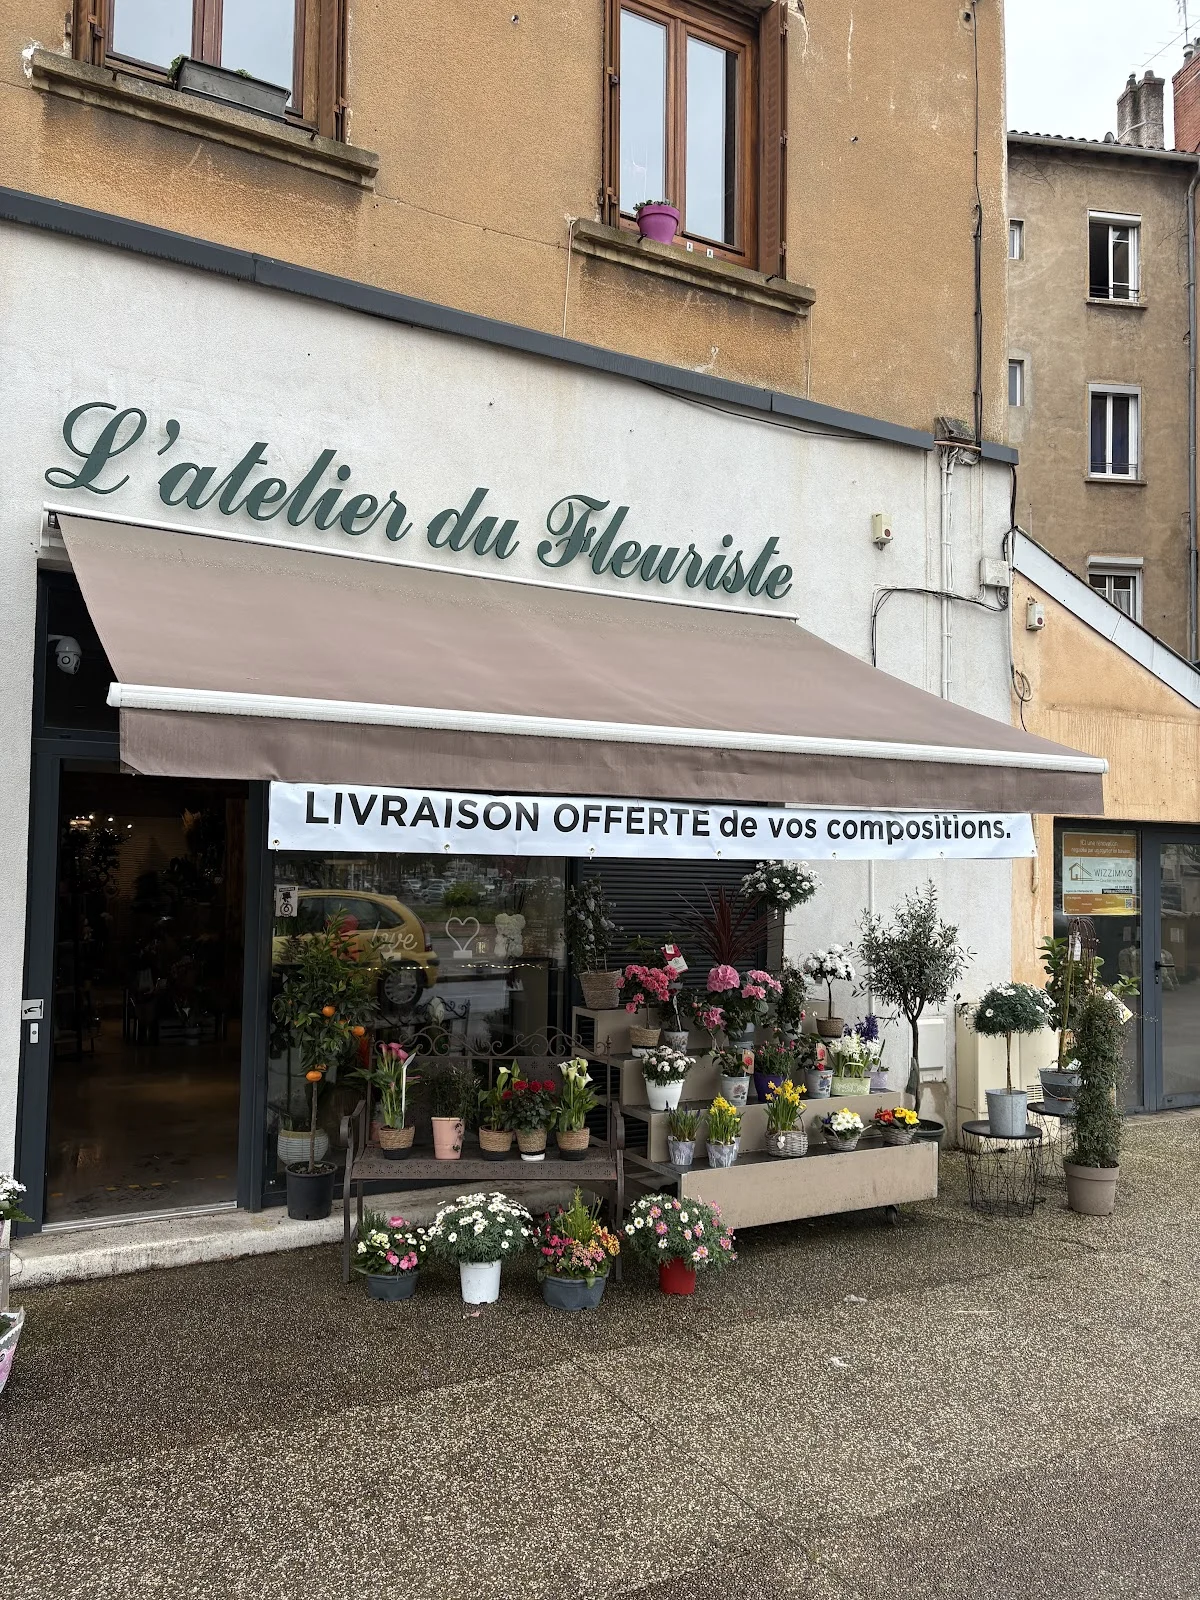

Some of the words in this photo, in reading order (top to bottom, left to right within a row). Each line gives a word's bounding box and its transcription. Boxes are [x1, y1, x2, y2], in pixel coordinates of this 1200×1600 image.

[45, 401, 414, 542] L'atelier
[427, 487, 520, 560] du
[537, 495, 793, 600] Fleuriste
[305, 791, 539, 832] LIVRAISON
[553, 803, 710, 837] OFFERTE
[720, 810, 758, 838] de
[768, 817, 817, 839] vos
[826, 814, 1011, 846] compositions.
